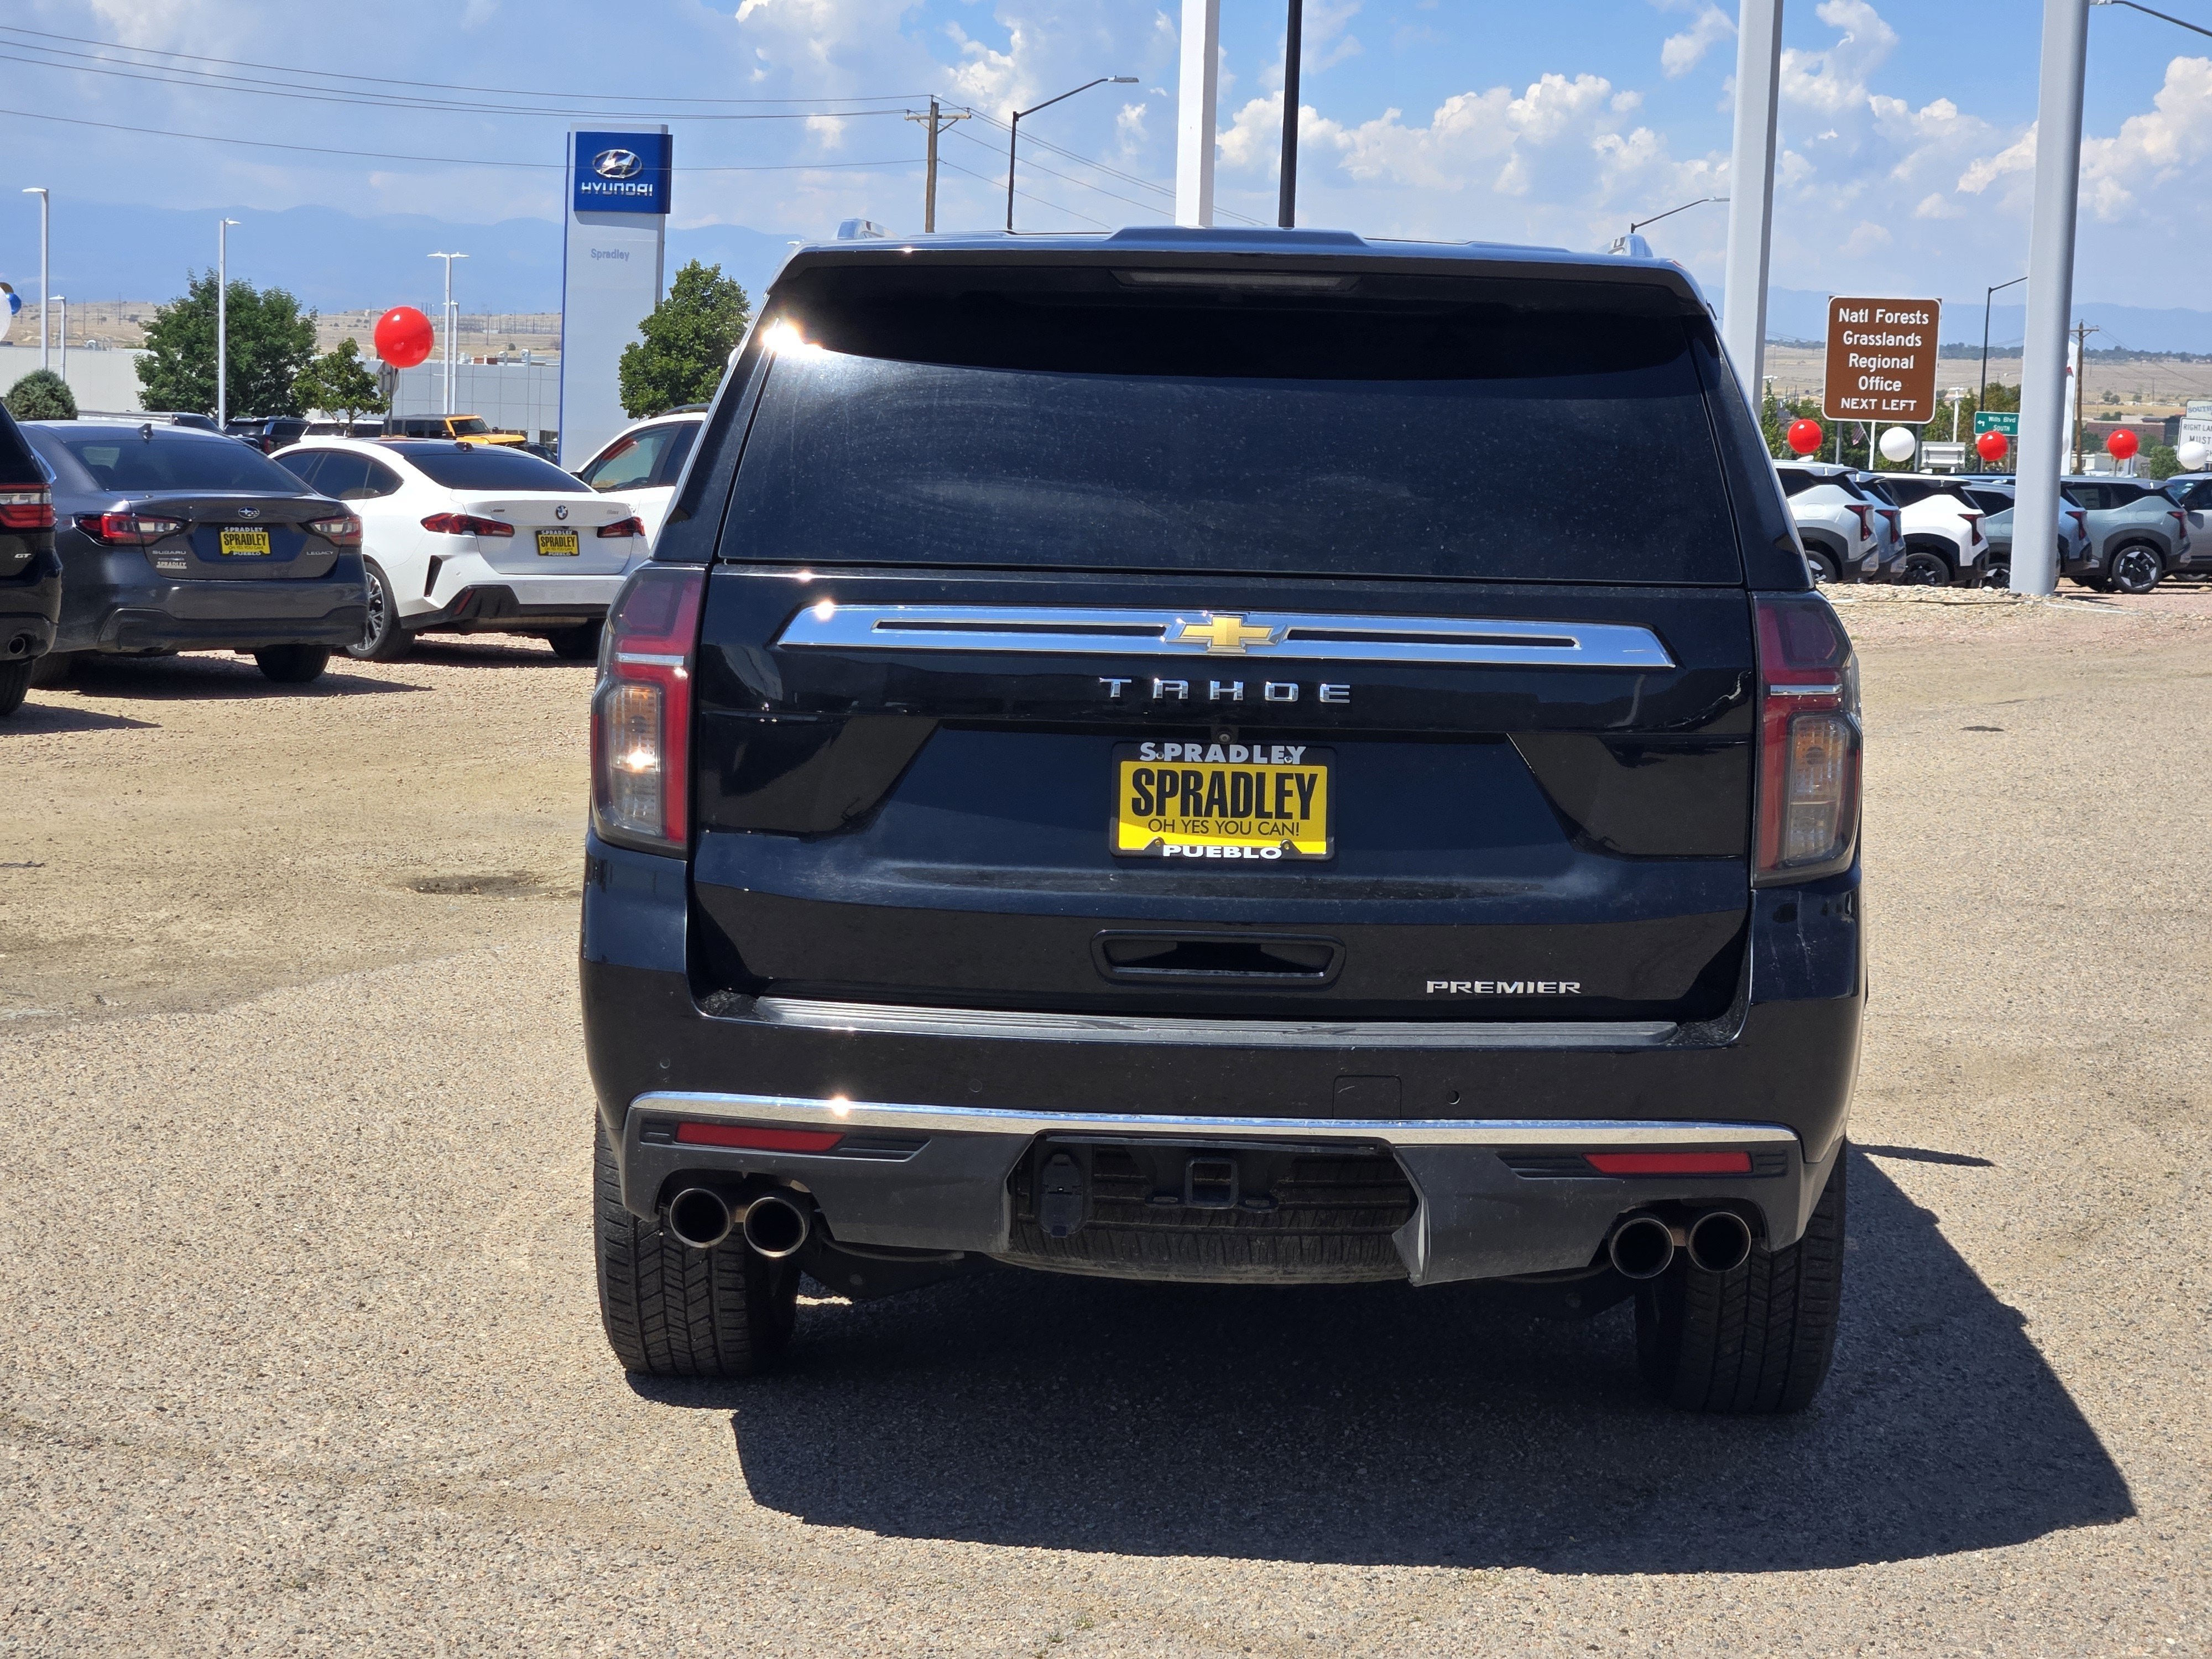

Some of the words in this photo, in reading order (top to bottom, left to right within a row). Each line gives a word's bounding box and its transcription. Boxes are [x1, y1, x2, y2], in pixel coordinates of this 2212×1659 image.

[581, 182, 653, 196] HYUNDAI
[591, 248, 630, 262] Spradley
[1839, 308, 1869, 322] Natl
[1875, 309, 1929, 325] Forests
[1843, 331, 1922, 347] Grasslands
[1849, 353, 1914, 372] Regional
[1858, 375, 1902, 392] Office
[1840, 398, 1877, 410] NEXT
[1882, 399, 1917, 411] LEFT
[223, 534, 266, 546] SPRADLEY
[540, 536, 575, 547] SPRADLEY
[1099, 677, 1350, 703] TAHOE
[1139, 742, 1307, 765] SPRADLEY
[1131, 768, 1318, 820] SPRADLEY
[1148, 818, 1175, 833] OH
[1181, 820, 1209, 834] YES
[1215, 821, 1252, 835] YOU
[1258, 821, 1300, 836] CAN!
[1163, 844, 1282, 860] PUEBLO
[1426, 980, 1582, 994] PREMIER
